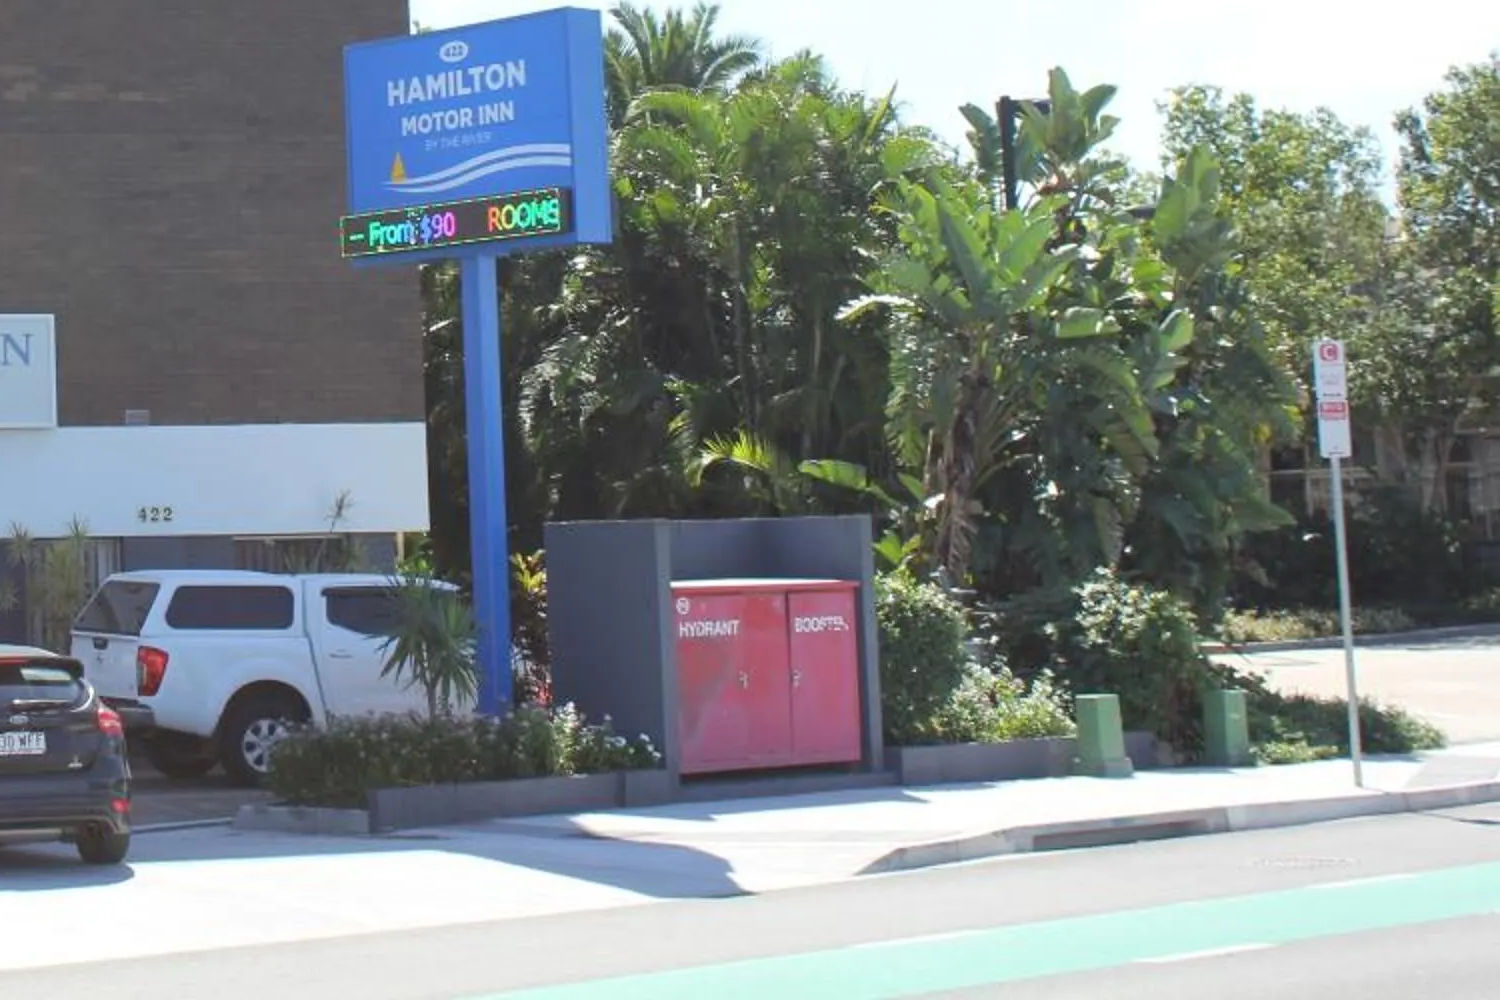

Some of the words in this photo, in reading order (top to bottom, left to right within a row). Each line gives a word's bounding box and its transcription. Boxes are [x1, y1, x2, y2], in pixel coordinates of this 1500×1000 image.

[387, 59, 526, 107] HAMILTON
[402, 107, 473, 136] MOTOR
[479, 101, 514, 125] INN
[138, 506, 173, 522] 422
[679, 619, 740, 637] HYDRANT
